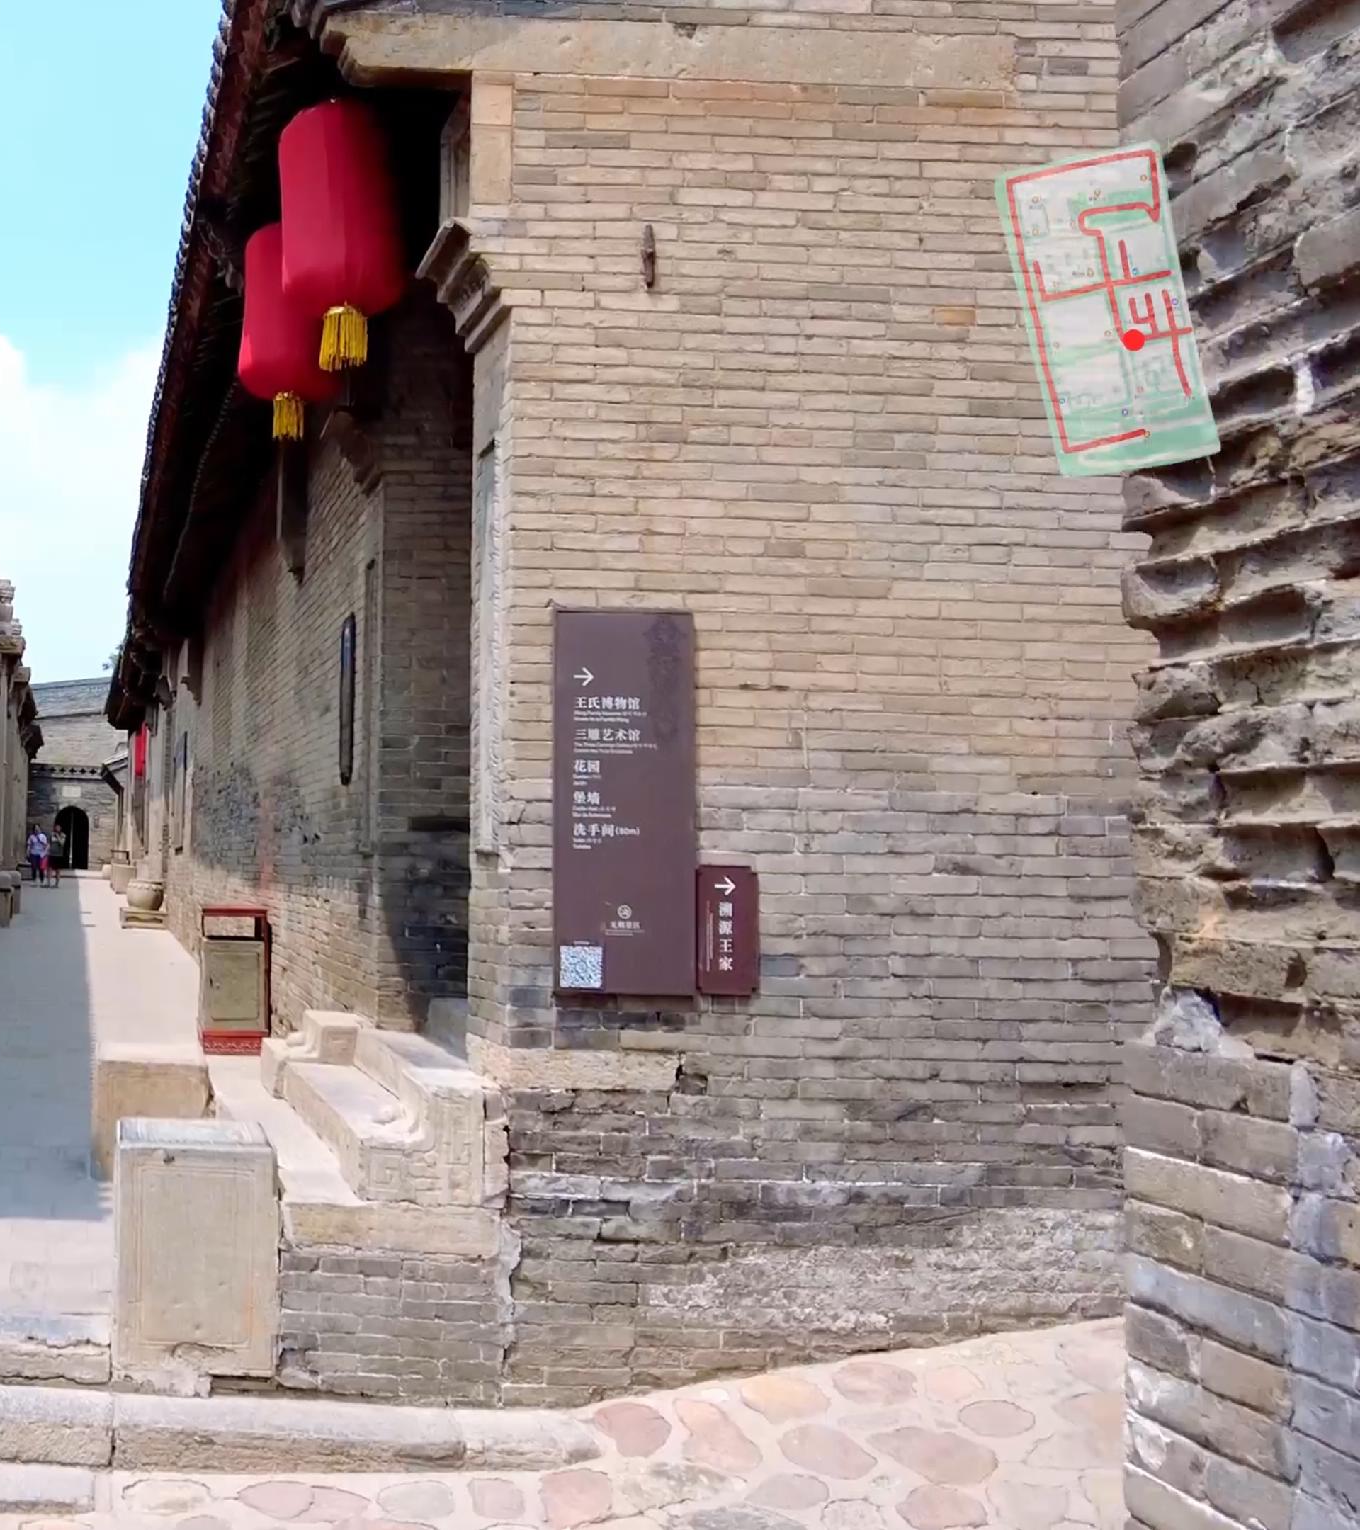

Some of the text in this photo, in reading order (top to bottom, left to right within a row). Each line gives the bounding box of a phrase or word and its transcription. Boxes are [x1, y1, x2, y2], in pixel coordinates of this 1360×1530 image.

[574, 696, 641, 710] 王氏博物馆
[574, 728, 641, 742] 三雕艺术馆
[573, 759, 600, 773] 花园
